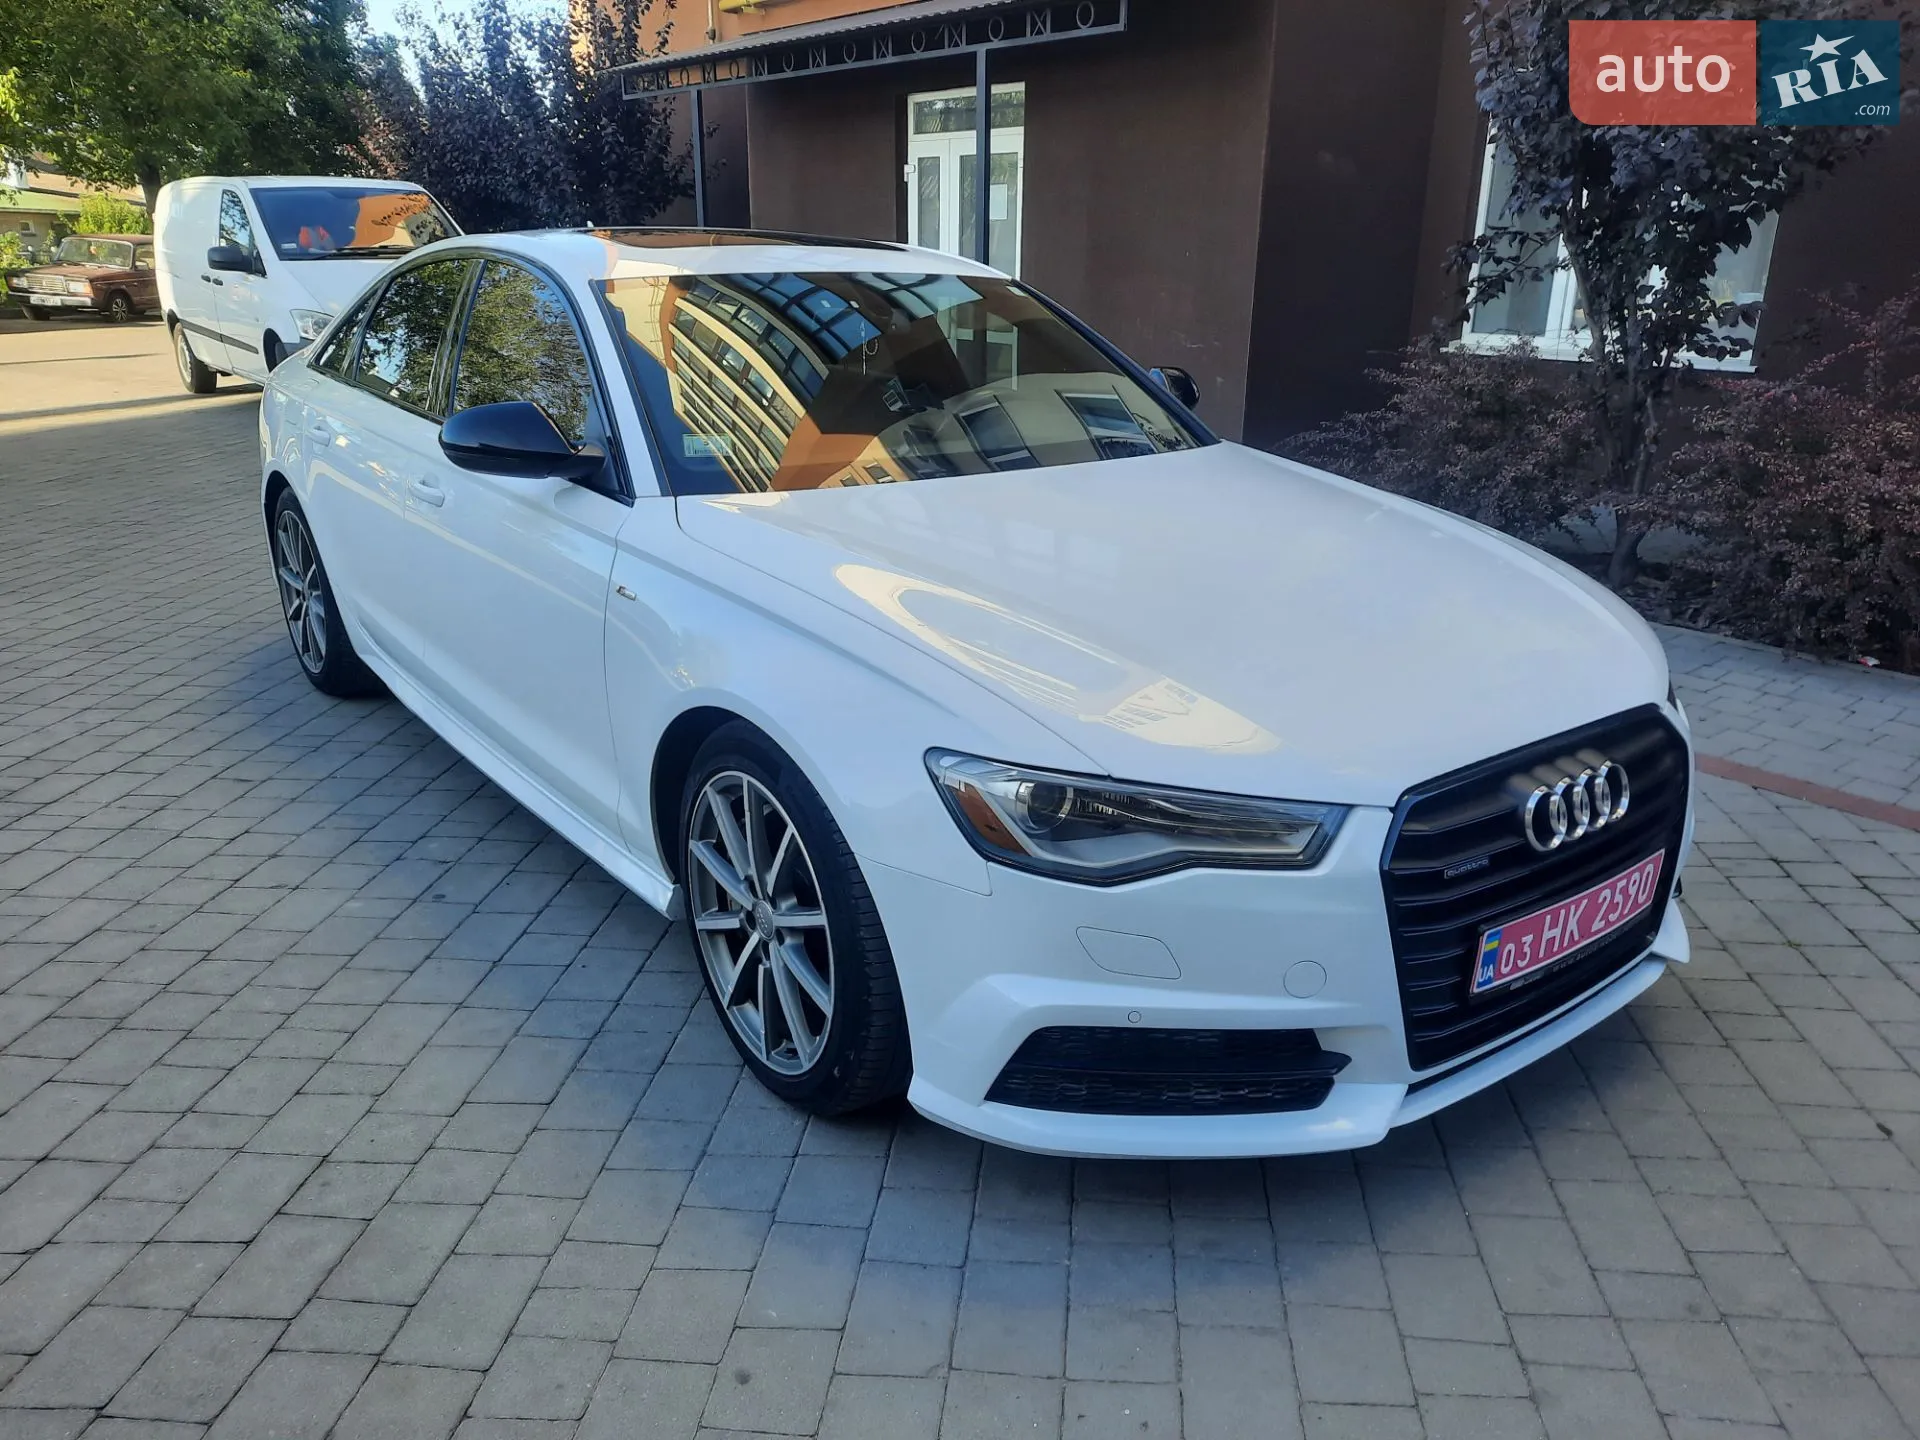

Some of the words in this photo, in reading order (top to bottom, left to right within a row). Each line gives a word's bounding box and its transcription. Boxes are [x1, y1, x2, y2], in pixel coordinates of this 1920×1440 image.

[1500, 933, 1534, 975] 03
[1538, 898, 1589, 958] HK
[1590, 863, 1655, 933] 2590
[1478, 964, 1494, 982] UA
